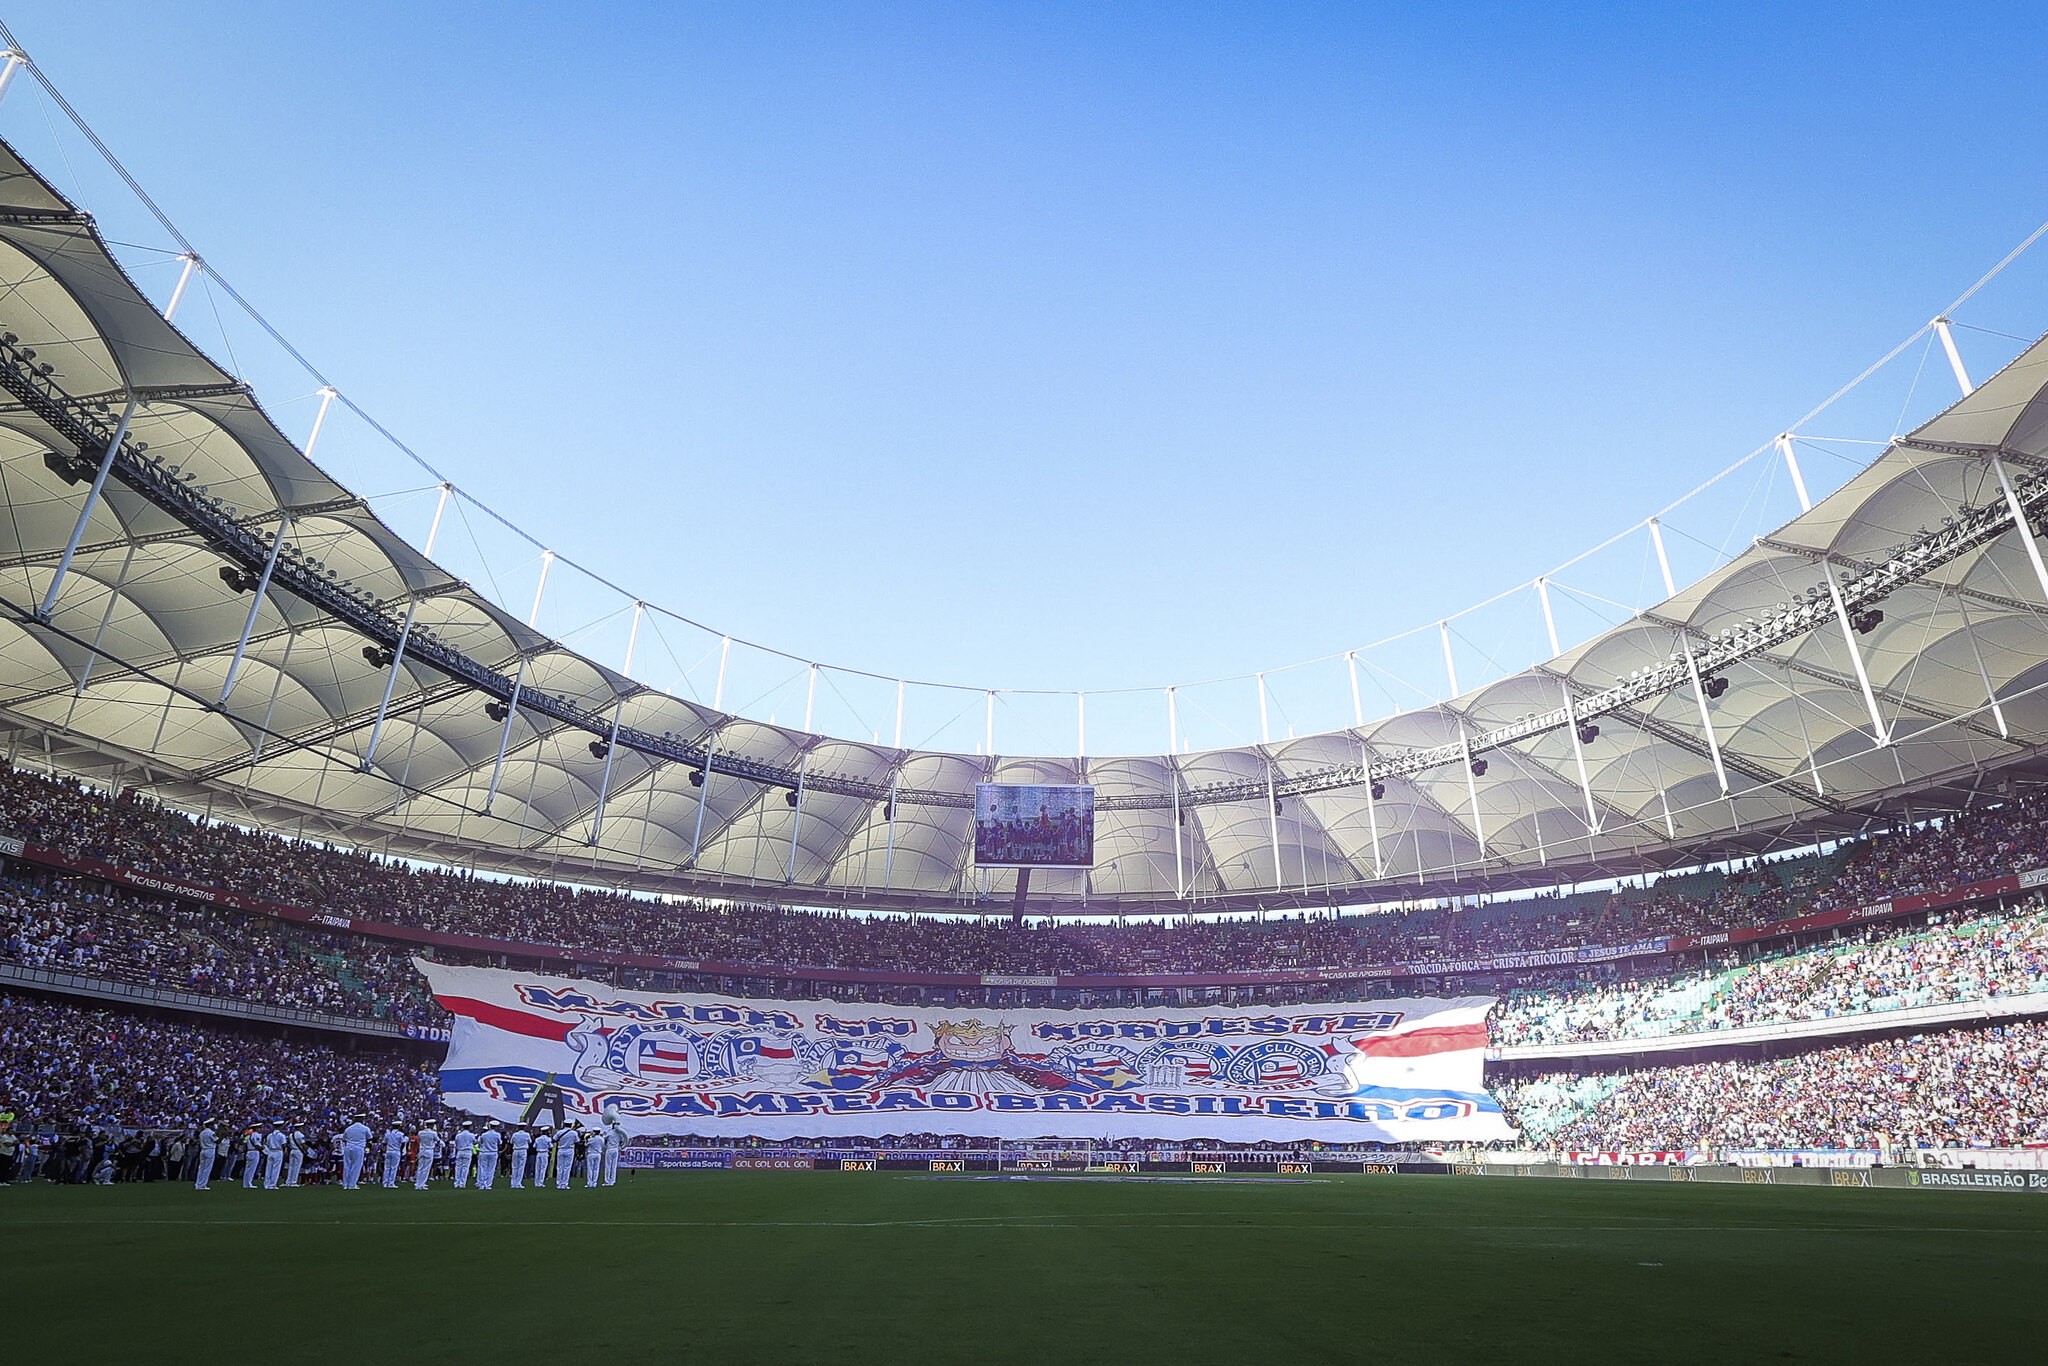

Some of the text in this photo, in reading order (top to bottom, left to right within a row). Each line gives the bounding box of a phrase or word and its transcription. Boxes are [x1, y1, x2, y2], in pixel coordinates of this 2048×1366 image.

[137, 876, 216, 901] CASA DE APOSTAS
[1861, 902, 1893, 918] ITAIPAVA
[322, 915, 351, 929] ITAIPAVA
[1700, 932, 1729, 946] ITAIPAVA
[1588, 942, 1653, 958] JESUS TE AMA
[1409, 963, 1448, 975] TORCIDA
[1449, 960, 1480, 973] FORÇA
[1528, 952, 1575, 968] TRICOLOR
[1359, 969, 1392, 977] APOSTAS
[519, 986, 799, 1030] MAIOR
[1035, 1013, 1401, 1041] NORDESTE!
[1265, 1043, 1312, 1060] CLUBE
[991, 1091, 1462, 1122] BRASILEIRO
[702, 1160, 722, 1168] Sorte
[735, 1160, 810, 1168] GOL GOL GOL GOL
[844, 1162, 873, 1171] BRAX
[932, 1162, 961, 1171] BRAX
[1107, 1164, 1136, 1173] BRAX
[1194, 1164, 1222, 1173] BRAX
[1280, 1164, 1309, 1173] BRAX
[1366, 1164, 1395, 1174] BRAX
[1456, 1166, 1484, 1175] BRAX
[1559, 1166, 1577, 1177] BRAX
[1611, 1166, 1630, 1179] BRAX
[1671, 1168, 1694, 1182] BRAX
[1744, 1170, 1772, 1184] BRAX
[1833, 1171, 1869, 1187] BRAX
[1922, 1171, 2048, 1187] BRASILEIRÃO Be
